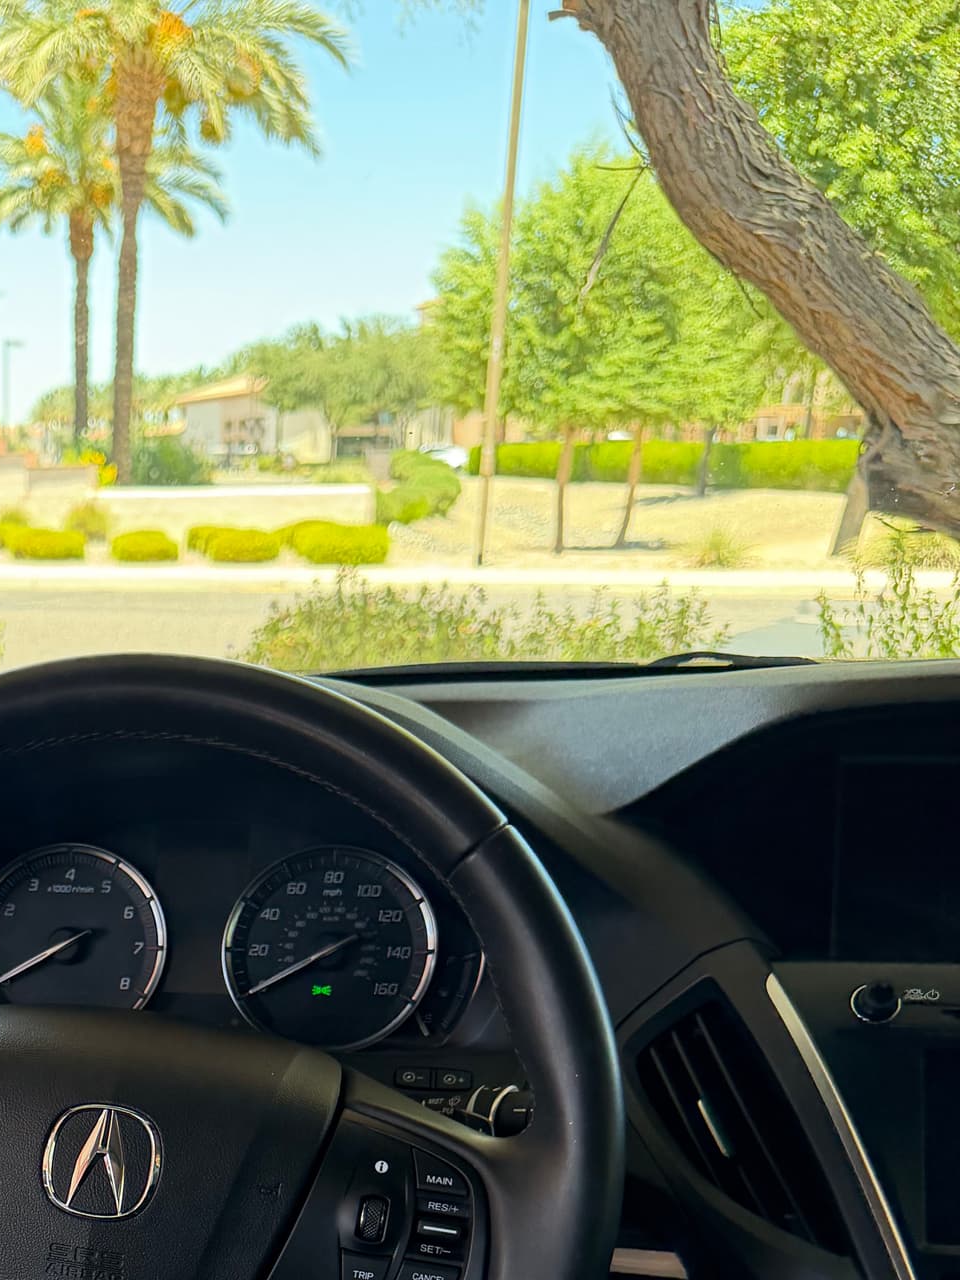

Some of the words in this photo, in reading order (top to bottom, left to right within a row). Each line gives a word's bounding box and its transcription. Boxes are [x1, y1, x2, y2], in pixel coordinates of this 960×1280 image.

[65, 869, 76, 881] 4
[323, 871, 344, 884] 80
[28, 879, 39, 892] 3
[101, 880, 112, 893] 5
[286, 882, 307, 895] 60
[357, 884, 382, 898] 100
[322, 888, 343, 898] mph
[4, 903, 16, 916] 2
[123, 906, 134, 919] 6
[260, 908, 280, 920] 40
[378, 909, 403, 922] 120
[133, 942, 144, 954] 7
[248, 944, 269, 956] 20
[387, 946, 411, 959] 140
[120, 977, 130, 990] 8
[374, 982, 398, 995] 160
[426, 1175, 453, 1186] MAIN
[428, 1201, 459, 1213] RES/+
[352, 1270, 374, 1280] TRIP
